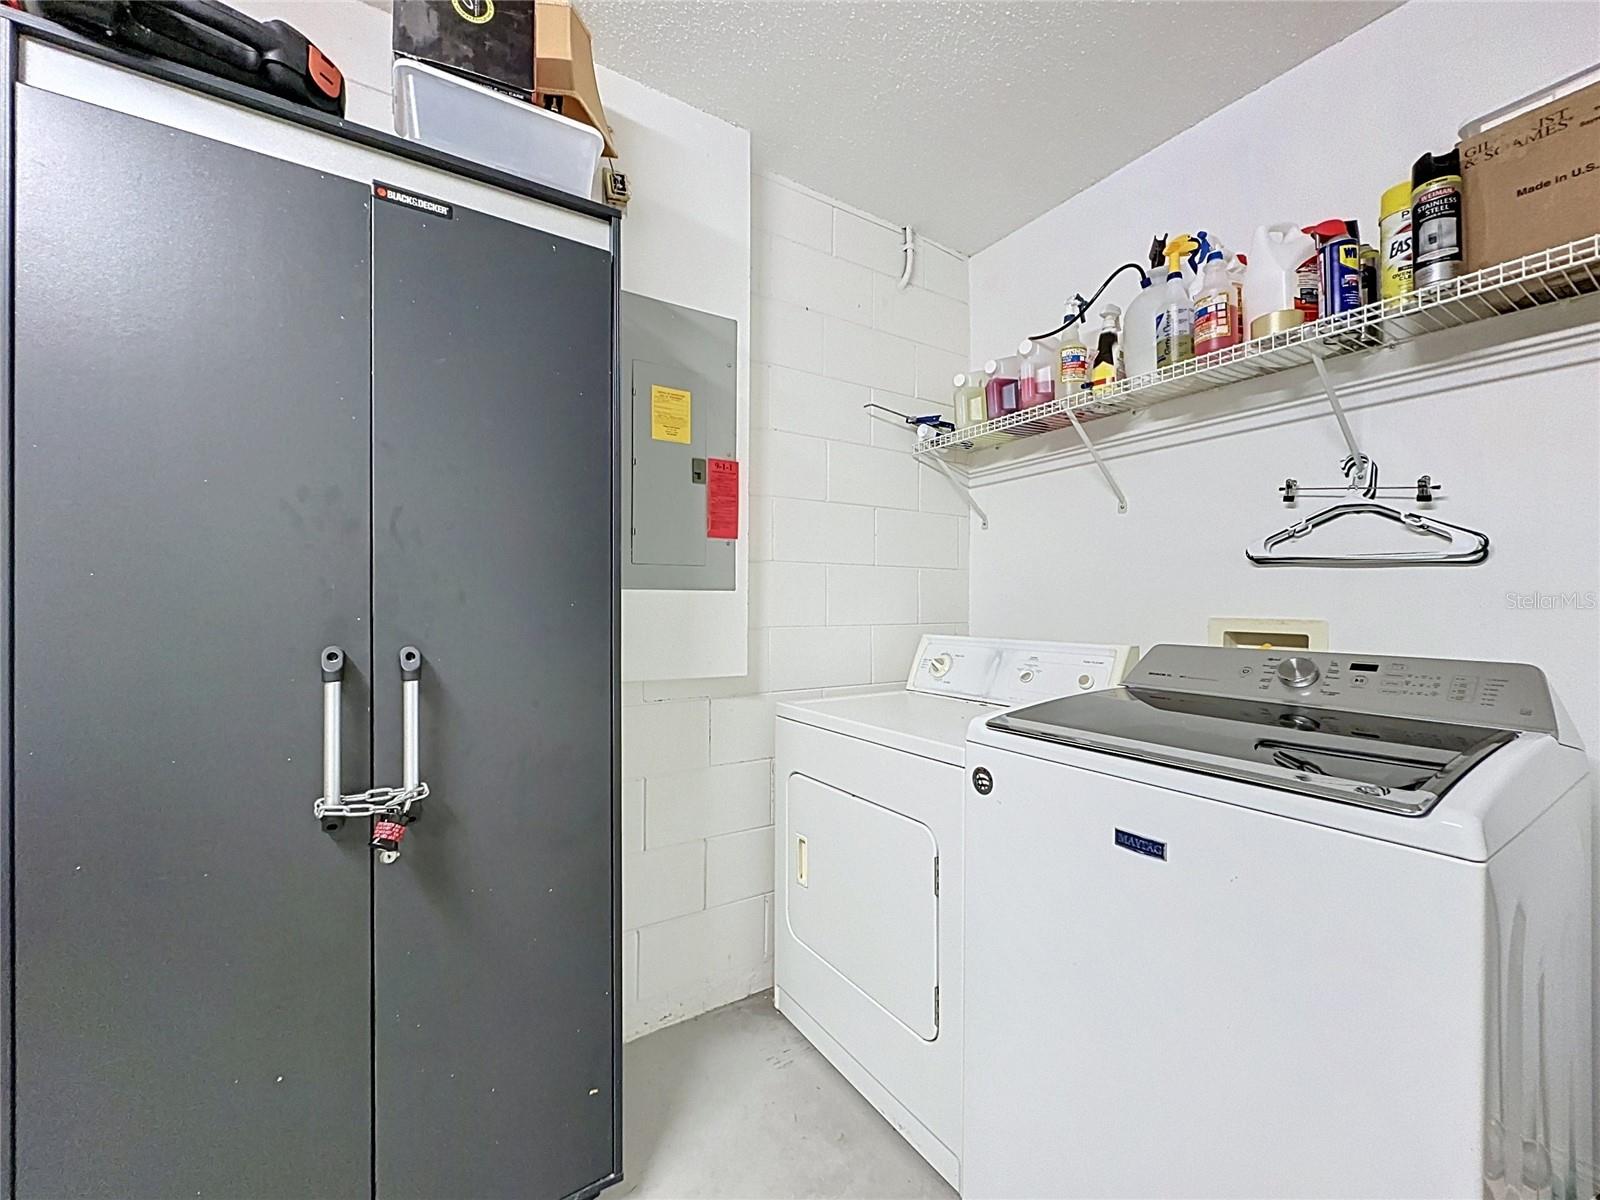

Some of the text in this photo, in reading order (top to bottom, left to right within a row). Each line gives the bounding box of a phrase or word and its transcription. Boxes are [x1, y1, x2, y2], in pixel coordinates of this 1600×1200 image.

[1420, 187, 1453, 202] WEIMAN
[1516, 180, 1552, 198] Made
[1555, 174, 1568, 185] in
[386, 189, 448, 216] BLACK&DECKER
[1417, 196, 1457, 213] STAINLESS
[1425, 204, 1449, 216] STEEL
[714, 462, 733, 471] 9-1-1
[1117, 832, 1163, 855] MAYTAG
